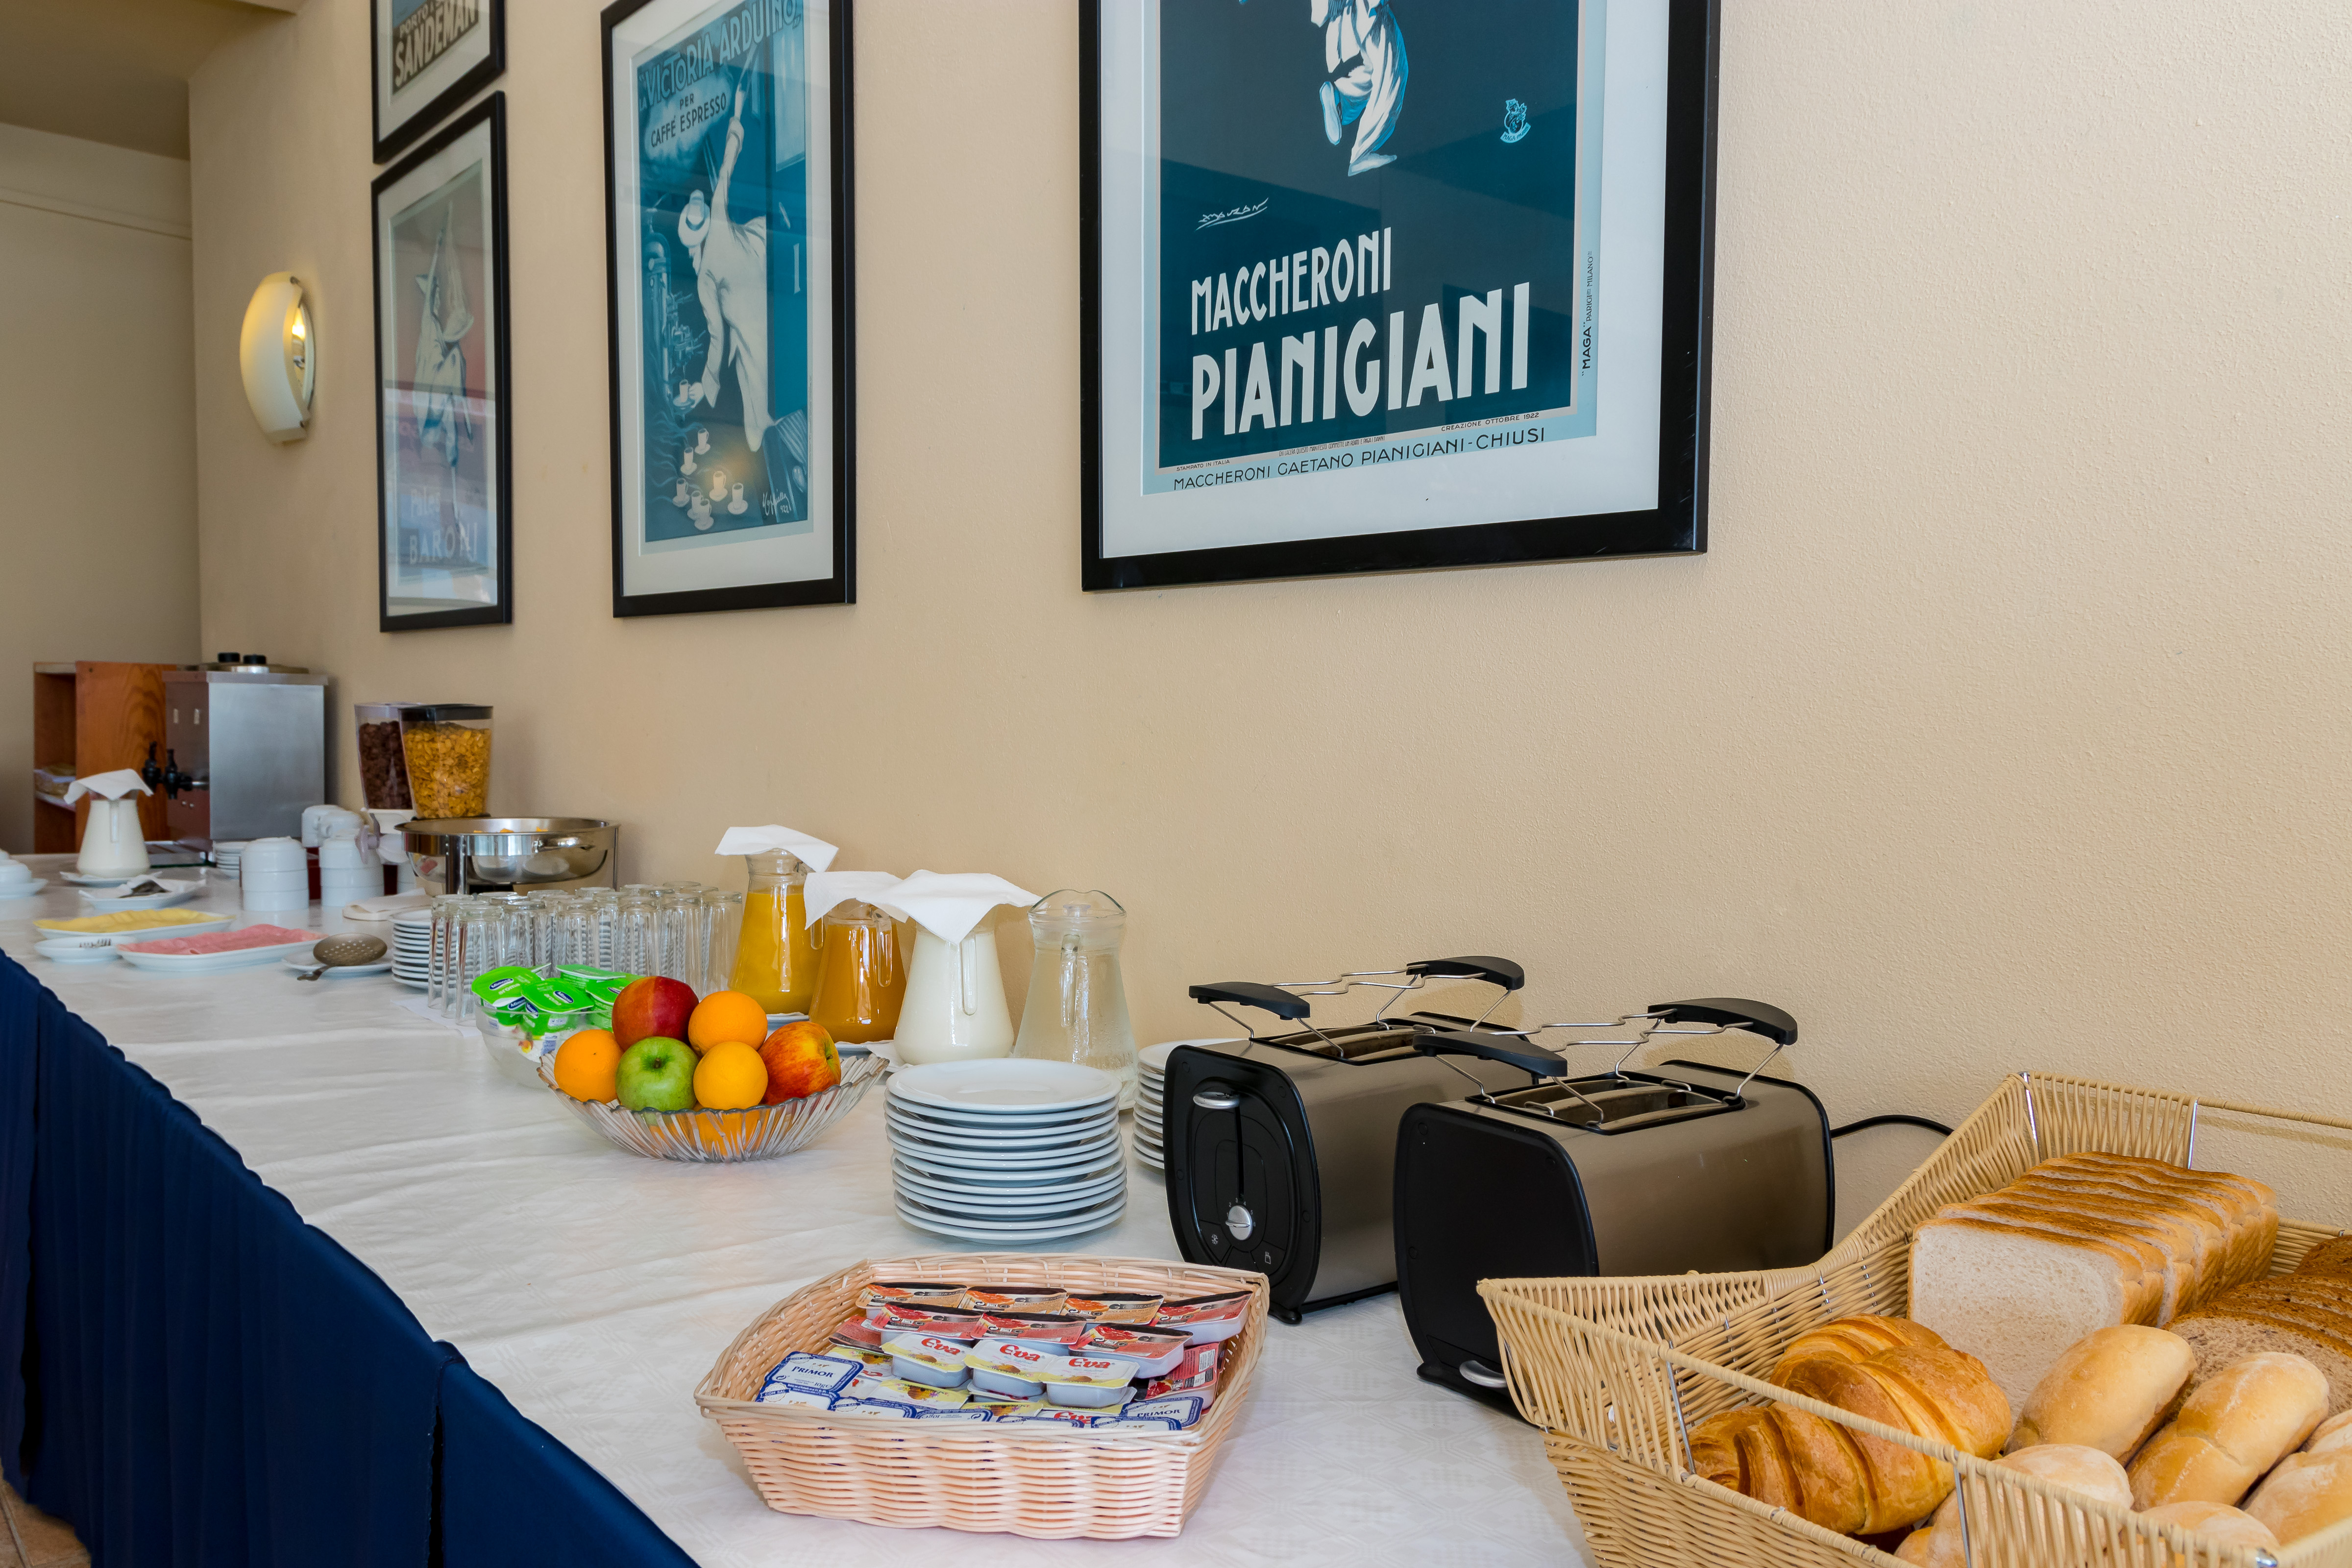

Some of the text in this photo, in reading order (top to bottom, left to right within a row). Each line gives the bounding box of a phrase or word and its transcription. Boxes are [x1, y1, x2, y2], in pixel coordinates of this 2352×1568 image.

[679, 93, 694, 110] PER
[680, 92, 727, 132] ESPRESSO
[1192, 227, 1391, 336] MACCHERONI
[1192, 282, 1530, 441] PIANIGIANI
[1441, 420, 1482, 432] CREAZIONE
[1485, 415, 1520, 425] OTTOBRE
[1309, 444, 1327, 452] MANIFESTO
[1174, 465, 1271, 490] MACCHERONI
[1277, 452, 1354, 476] GAETANO
[1176, 463, 1204, 471] STAMPATO
[410, 522, 478, 564] BARONI
[498, 983, 520, 995] aroma
[921, 1338, 960, 1355] Eva
[1000, 1344, 1041, 1362] Eva
[791, 1366, 834, 1378] PRIMOR
[1069, 1358, 1111, 1369] Eva
[1137, 1409, 1180, 1418] PRIMOR
